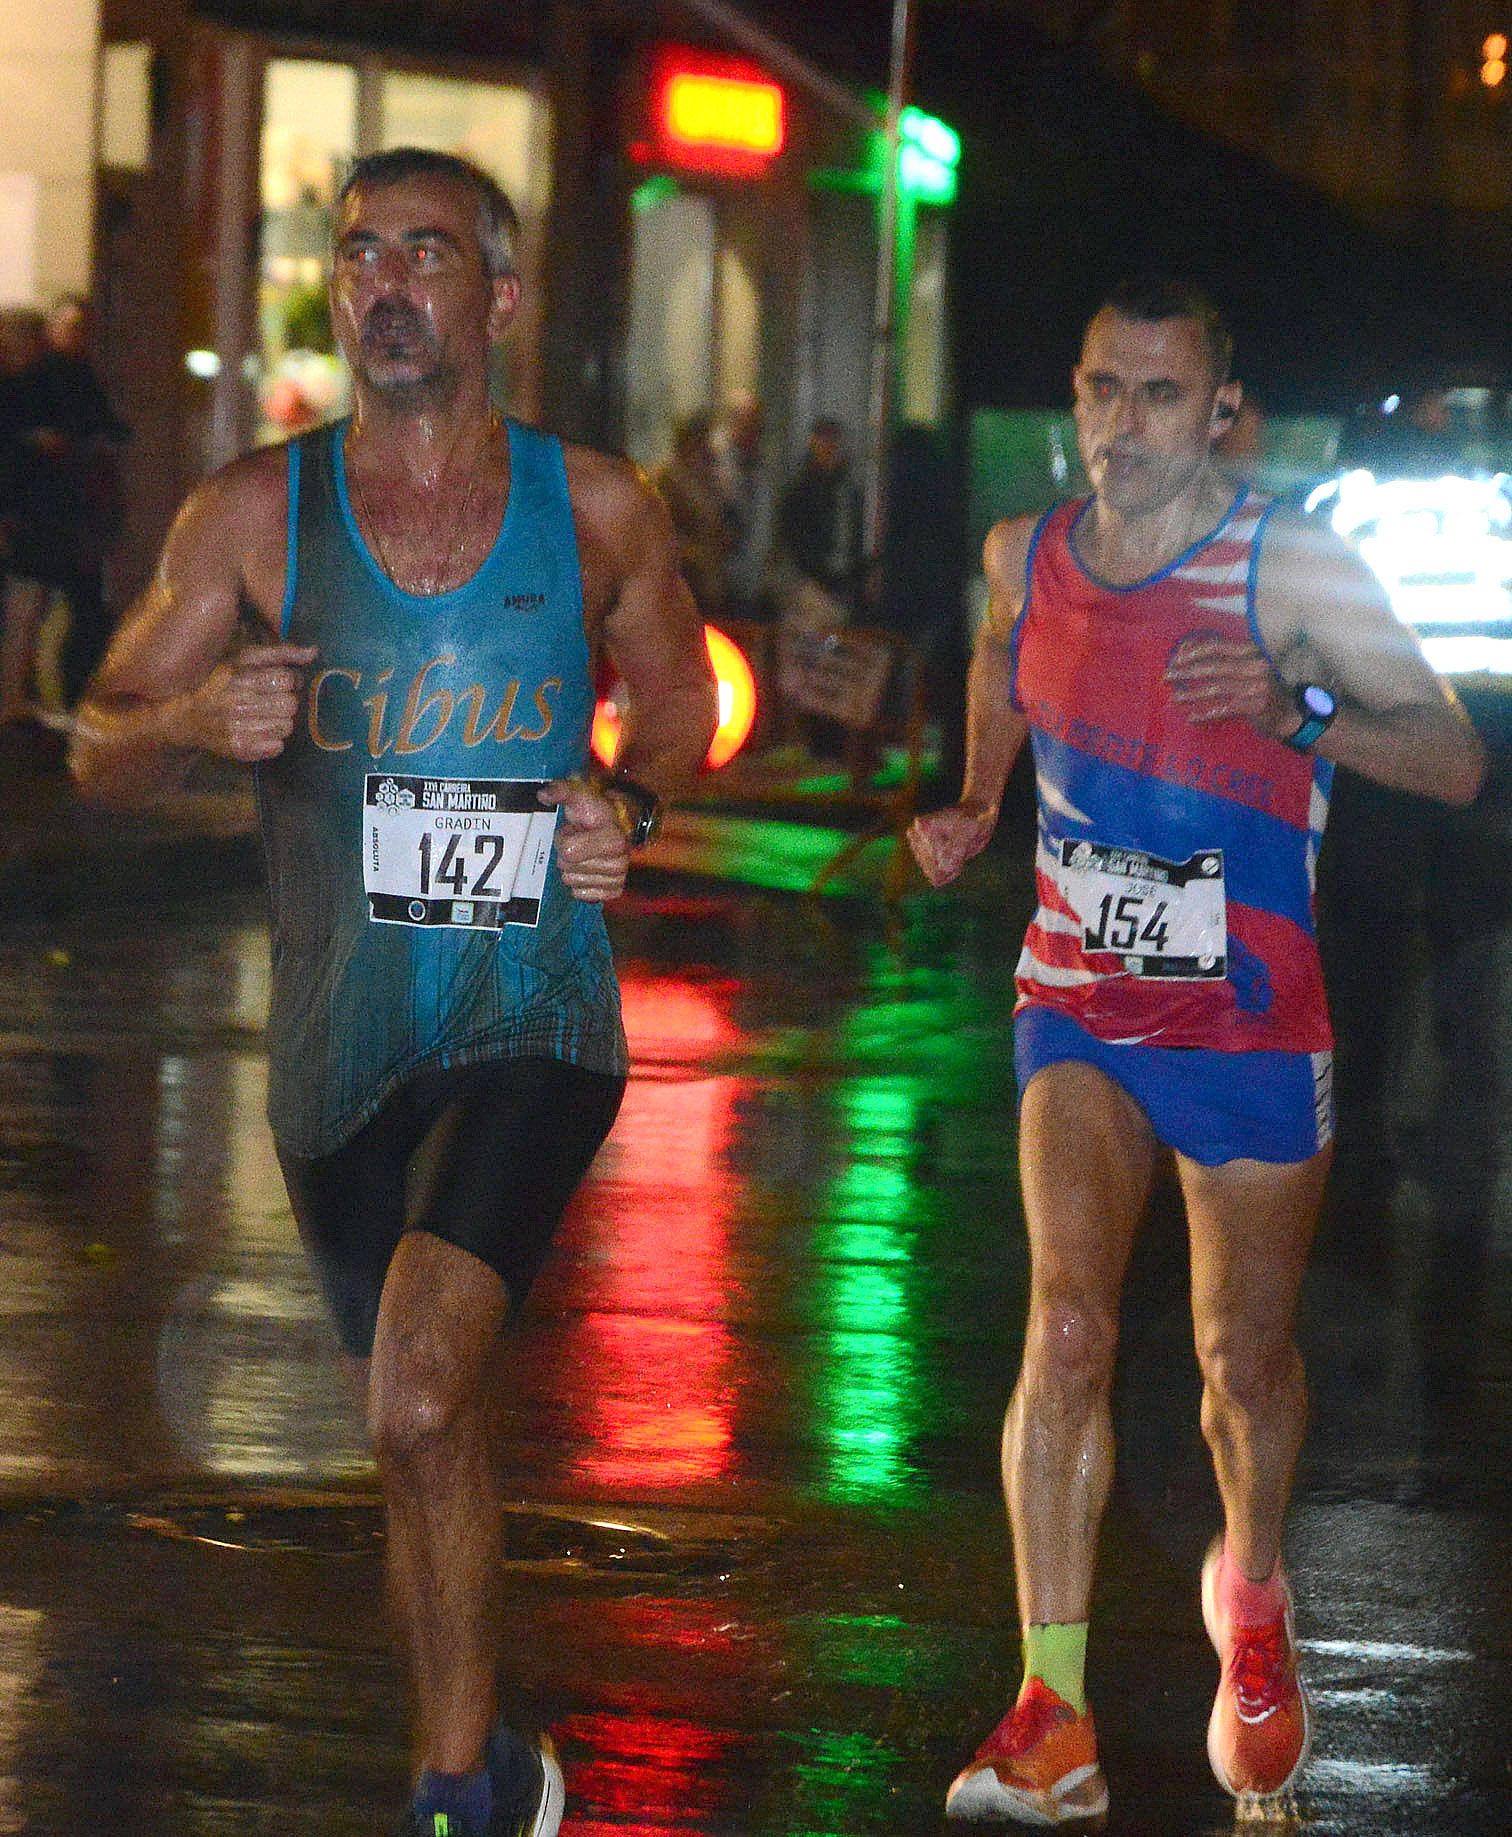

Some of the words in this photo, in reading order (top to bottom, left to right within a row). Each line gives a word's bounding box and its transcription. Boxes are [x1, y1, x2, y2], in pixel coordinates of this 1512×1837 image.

[309, 653, 562, 757] Cibus
[422, 792, 444, 809] SAN
[434, 816, 491, 830] GRADIN
[372, 826, 380, 872] ABSOLUTA
[418, 832, 505, 898] 142
[1099, 894, 1170, 951] 154
